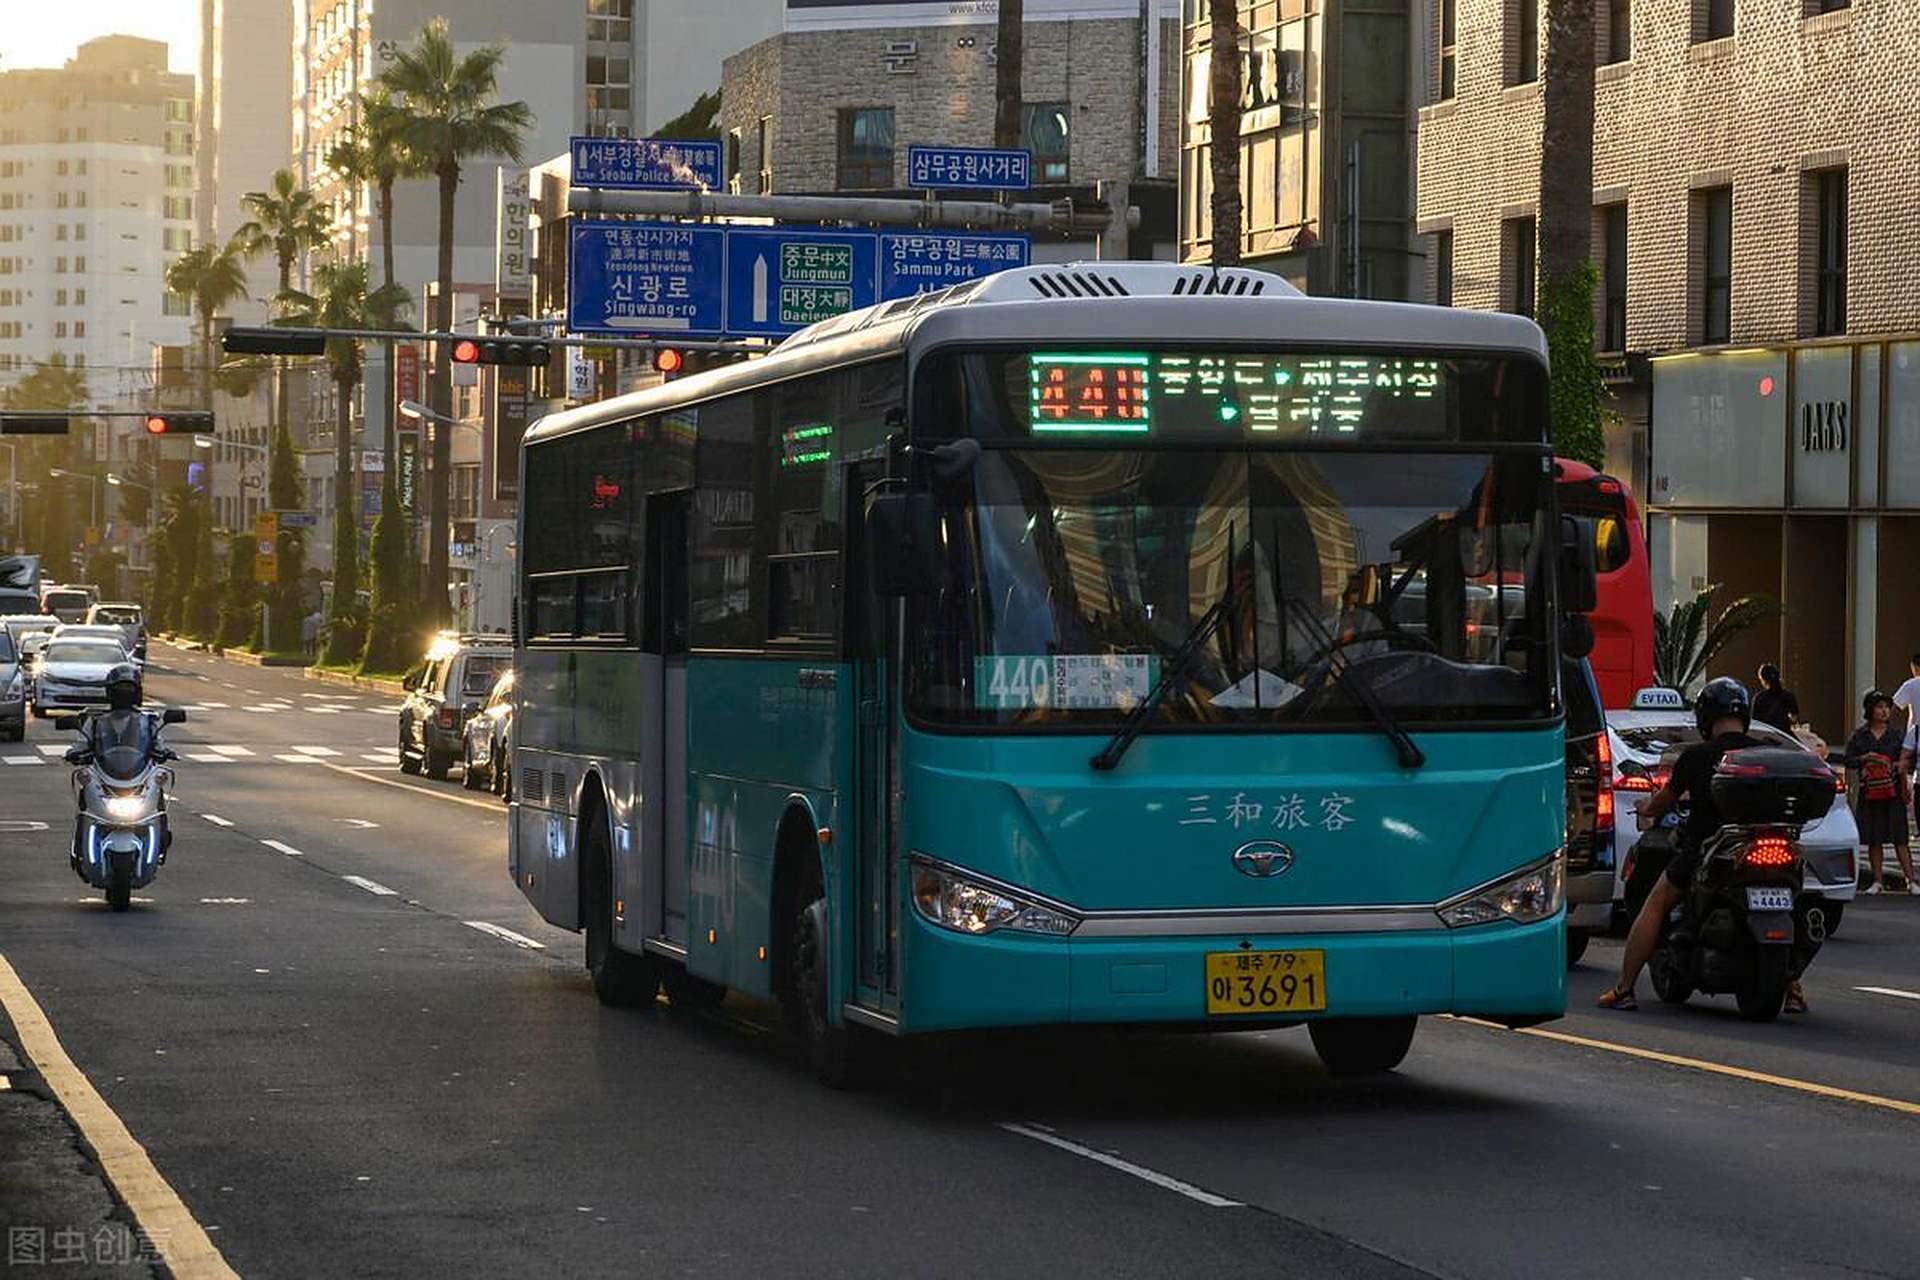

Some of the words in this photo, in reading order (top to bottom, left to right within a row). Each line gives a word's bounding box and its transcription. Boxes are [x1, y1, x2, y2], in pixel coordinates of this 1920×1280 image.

[600, 168, 634, 182] Seobu
[635, 169, 670, 183] Police
[914, 154, 1026, 182] 삼무공원사거리
[504, 202, 526, 276] 한의원
[605, 229, 693, 247] 연동신시가지
[785, 267, 846, 281] Jungmun
[894, 261, 942, 276] Sammu
[944, 263, 976, 278] Park
[611, 275, 691, 303] 신광로
[604, 300, 697, 318] Singwang-ro
[1040, 368, 1142, 418] 440
[988, 658, 1050, 708] 440
[1641, 693, 1654, 705] EV
[1656, 693, 1678, 705] TAXI
[1178, 791, 1357, 832] 三和旅客
[1237, 954, 1264, 971] 제주
[1269, 953, 1297, 971] 79
[1237, 974, 1315, 1007] 3691
